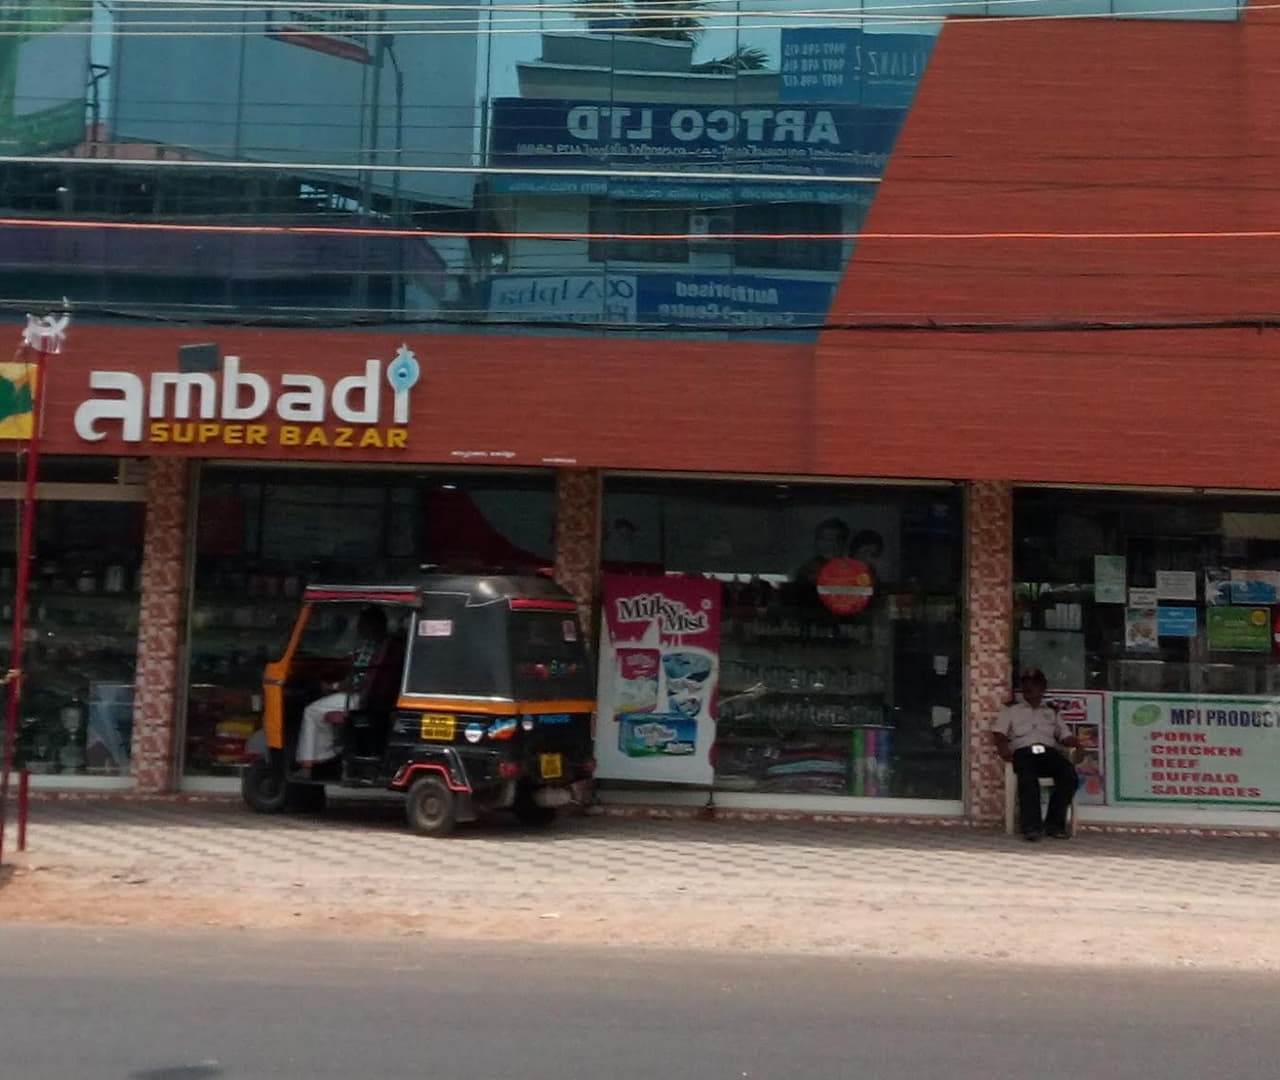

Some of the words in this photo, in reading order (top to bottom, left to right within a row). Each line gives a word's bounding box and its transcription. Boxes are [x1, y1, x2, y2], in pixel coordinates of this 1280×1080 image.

[73, 344, 420, 441] ambadi
[150, 422, 267, 446] SUPER
[278, 424, 409, 449] BAZAR
[618, 594, 681, 620] Milky
[663, 610, 707, 632] Mist
[1170, 708, 1202, 727] MPI
[1150, 731, 1207, 743] PORK
[1150, 745, 1243, 757] CHICKEN
[1151, 758, 1200, 769] BEEF
[1151, 772, 1239, 783] BUFFALO
[1151, 785, 1262, 798] SAUSAGES
